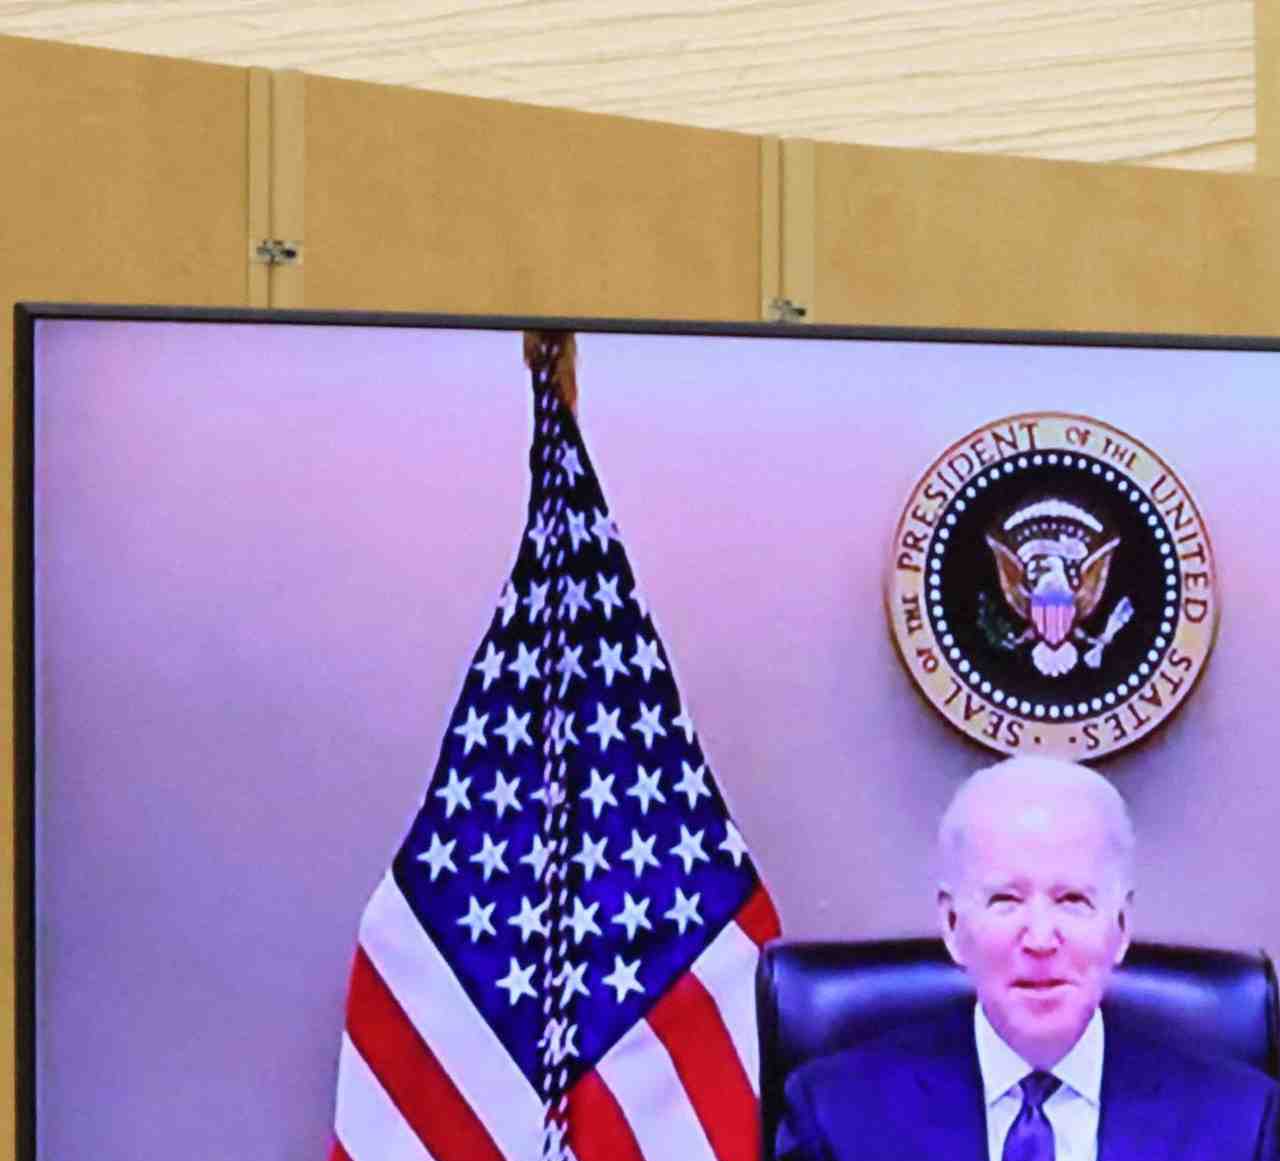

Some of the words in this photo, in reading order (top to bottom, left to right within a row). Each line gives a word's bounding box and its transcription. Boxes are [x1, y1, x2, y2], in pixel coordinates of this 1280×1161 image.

[896, 422, 1039, 574] PRESIDENT
[1149, 474, 1209, 625] UNITED
[943, 676, 1025, 748] SEAL
[1081, 648, 1193, 750] STATES
